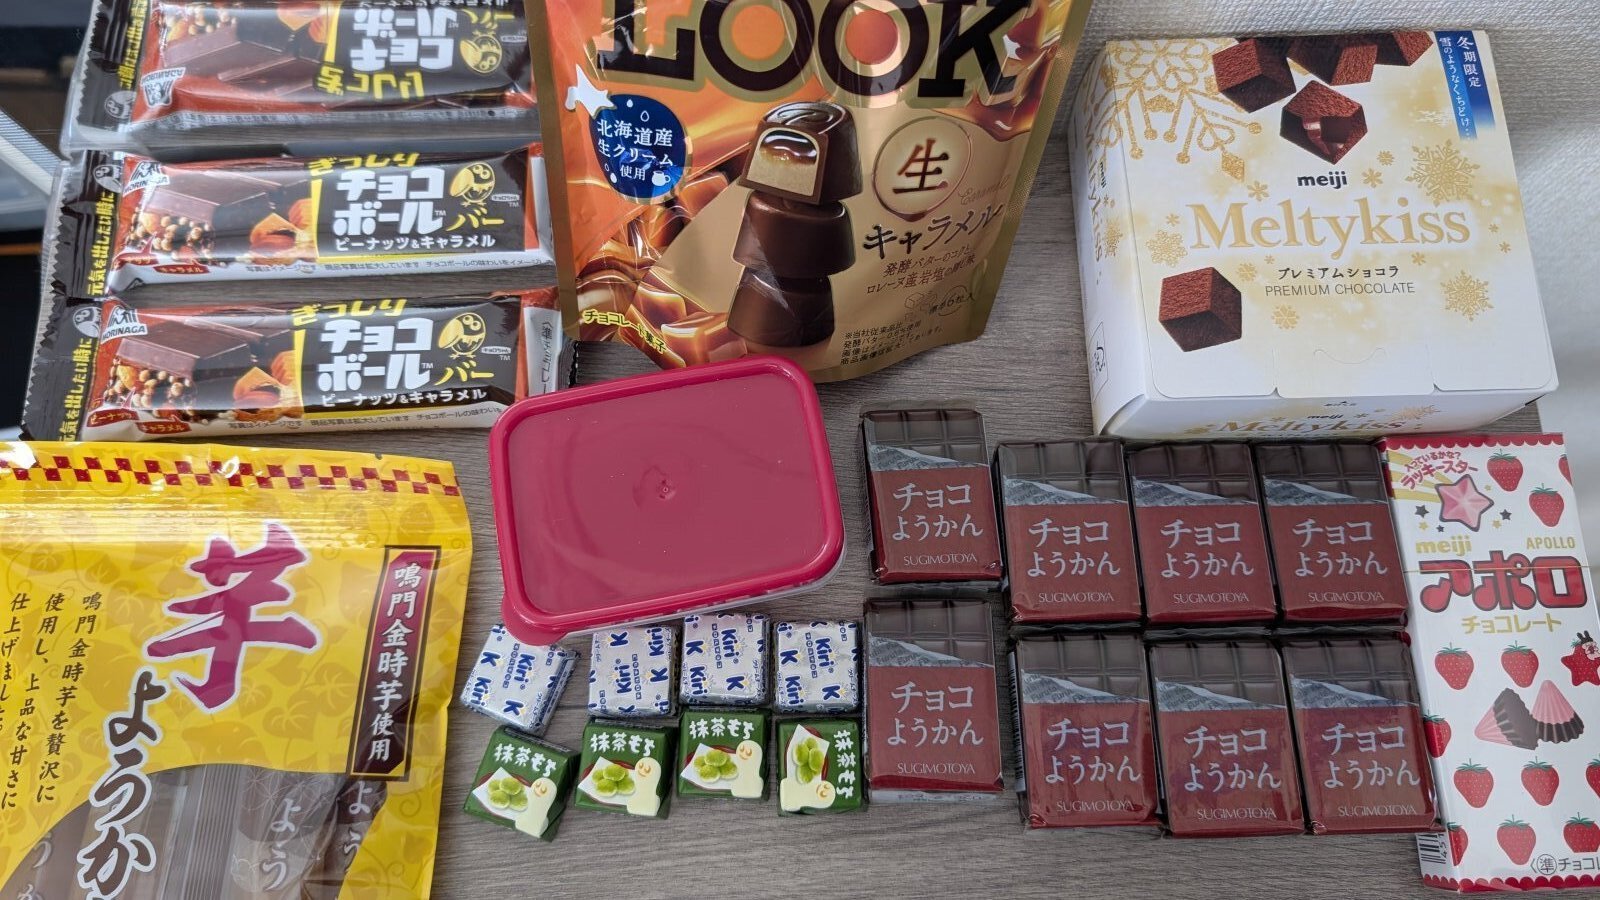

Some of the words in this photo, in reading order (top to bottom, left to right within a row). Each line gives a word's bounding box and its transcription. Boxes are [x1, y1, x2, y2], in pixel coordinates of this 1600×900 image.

[597, 0, 1028, 98] LOOK
[1457, 36, 1482, 88] 冬期限定
[597, 118, 673, 147] 北海道産
[308, 153, 420, 176] ぎっしり
[598, 138, 674, 167] 生クリーム
[892, 138, 949, 194] 生
[336, 168, 445, 201] チョコ
[619, 164, 646, 181] 使用
[1297, 171, 1347, 190] meiji
[333, 201, 443, 236] ボール
[446, 208, 505, 232] バー
[863, 204, 1004, 260] キャラメル
[1187, 197, 1472, 261] Meltykiss
[335, 235, 496, 251] ピーナッツ&キャラメル
[1278, 265, 1399, 281] プレミアムショコラ
[1265, 284, 1331, 297] PREMIUM
[1336, 281, 1415, 295] CHOCOLATE
[291, 298, 407, 325] ぎっしり
[321, 318, 433, 353] チョコ
[318, 354, 430, 392] ボール
[434, 361, 494, 386] バー
[321, 389, 488, 408] ピーナッツ&キャラメル
[1401, 460, 1479, 490] ラッキースター
[893, 482, 971, 512] チョコ
[892, 513, 983, 541] ようかん
[1028, 518, 1109, 548] チョコ
[1160, 519, 1241, 549] チョコ
[1292, 518, 1373, 548] チョコ
[1416, 535, 1473, 556] meiji
[1526, 536, 1577, 550] APOLLO
[903, 553, 977, 566] SUGIMOTOYA
[1027, 551, 1120, 578] ようかん
[1161, 551, 1254, 579] ようかん
[1294, 551, 1388, 578] ようかん
[1418, 550, 1588, 614] アポロ
[1039, 591, 1114, 603] SUGIMOTOYA
[1173, 592, 1250, 604] SUGIMOTOYA
[1308, 591, 1385, 603] SUGIMOTOYA
[147, 524, 318, 709] 芋
[1462, 613, 1562, 635] チョコレート
[610, 632, 629, 646] K
[647, 628, 664, 656] Kiri
[686, 640, 704, 656] K
[721, 629, 739, 658] Kiri
[815, 638, 834, 667] Kiri
[367, 563, 423, 762] 鳴門金時芋使用
[481, 652, 501, 667] K
[514, 654, 536, 682] Kiri
[780, 650, 799, 665] K
[615, 665, 632, 694] Kiri
[650, 667, 669, 682] K
[690, 666, 708, 695] Kiri
[726, 675, 745, 690] K
[1, 593, 65, 809] 使用し、上品な甘さに
[36, 592, 102, 803] 鳴門金時芋を贅沢に
[471, 676, 492, 706] Kiri
[785, 676, 804, 704] Kiri
[822, 685, 841, 700] K
[891, 680, 974, 714] チョコ
[503, 700, 524, 716] K
[689, 717, 755, 740] 抹茶もち
[887, 717, 984, 748] ようかん
[1047, 717, 1130, 751] チョコ
[1184, 725, 1267, 759] チョコ
[1321, 722, 1405, 756] チョコ
[590, 731, 656, 757] 抹茶もち
[494, 743, 557, 778] 抹茶もち
[833, 729, 857, 799] 抹茶もち
[897, 762, 976, 774] SUGIMOTOYA
[1045, 755, 1141, 785] ようかん
[1324, 759, 1420, 790] ようかん
[1184, 761, 1281, 793] ようかん
[1056, 800, 1134, 812] SUGIMOTOYA
[1197, 807, 1277, 820] SUGIMOTOYA
[1338, 804, 1417, 817] SUGIMOTOYA
